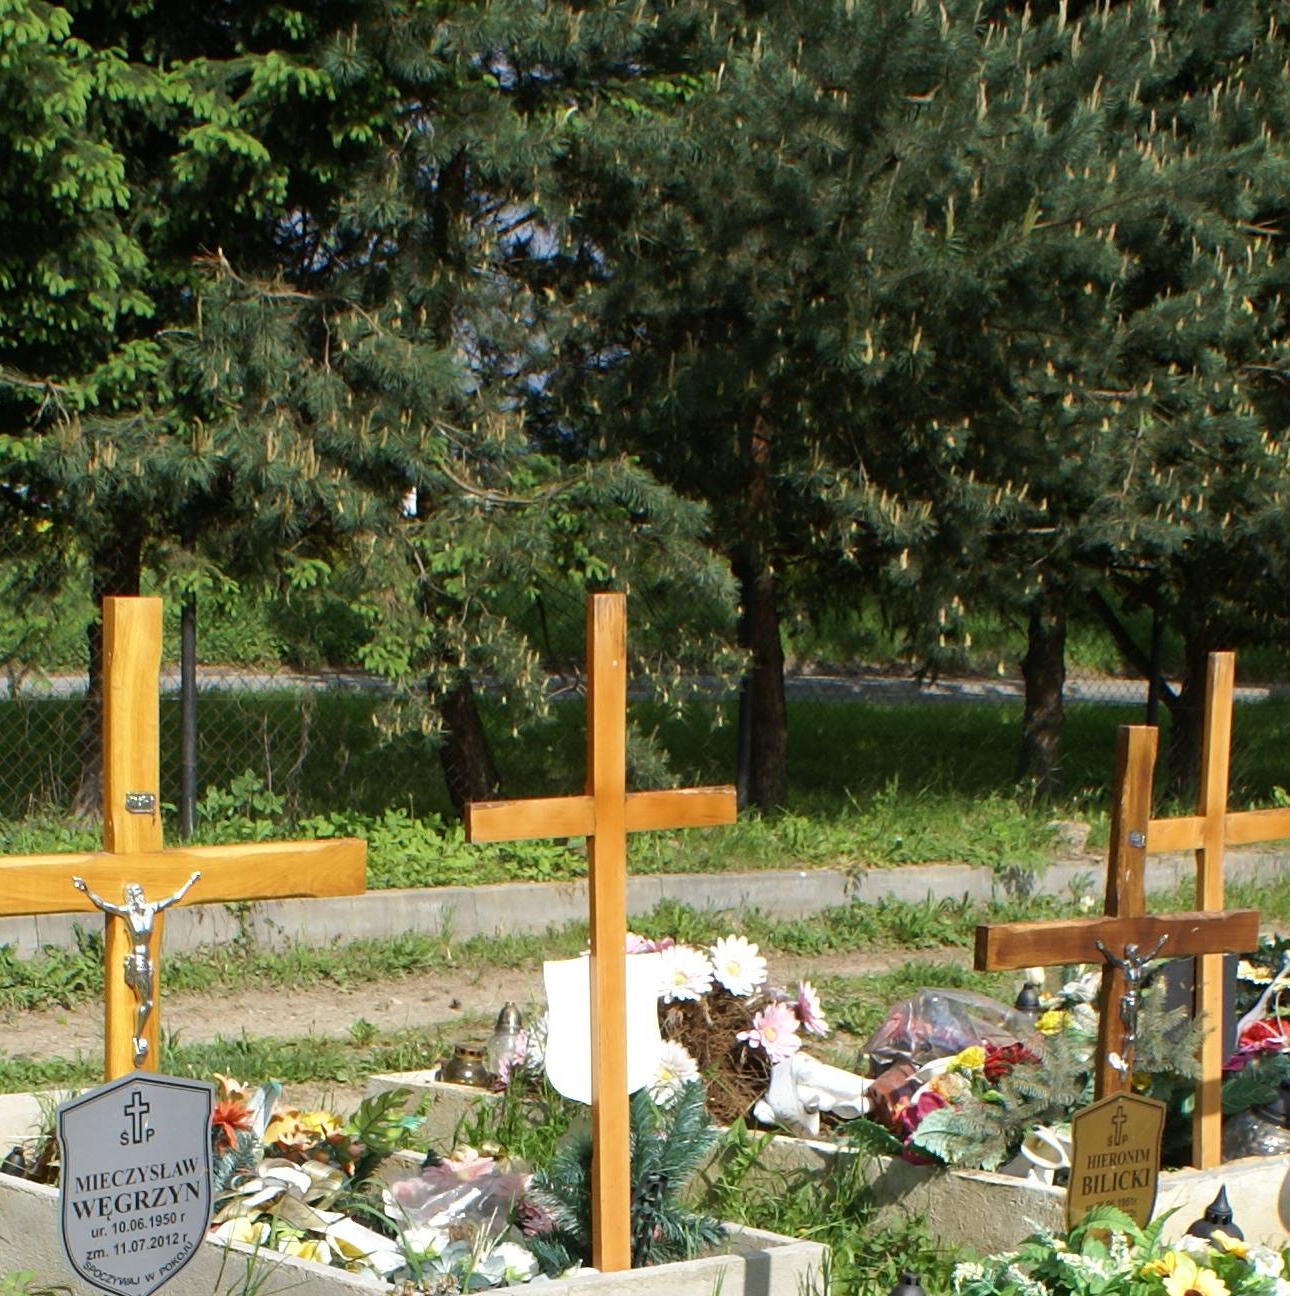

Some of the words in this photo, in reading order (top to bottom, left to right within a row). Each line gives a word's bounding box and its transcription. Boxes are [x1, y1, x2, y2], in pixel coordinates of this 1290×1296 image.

[120, 1129, 129, 1146] Ś
[146, 1128, 155, 1143] P
[1087, 1148, 1151, 1170] HIERONIM
[75, 1157, 199, 1194] MIECZYSŁAW
[1081, 1167, 1150, 1196] BILICKI
[72, 1181, 201, 1221] WĘGRZYN
[91, 1226, 107, 1239] ur.
[112, 1213, 177, 1235] 10.06.1950
[86, 1247, 108, 1261] zm.
[114, 1233, 179, 1255] 11.07.2012
[83, 1261, 140, 1286] SPOCZYWAJ
[145, 1272, 155, 1282] W
[159, 1240, 193, 1277] POKOJU
